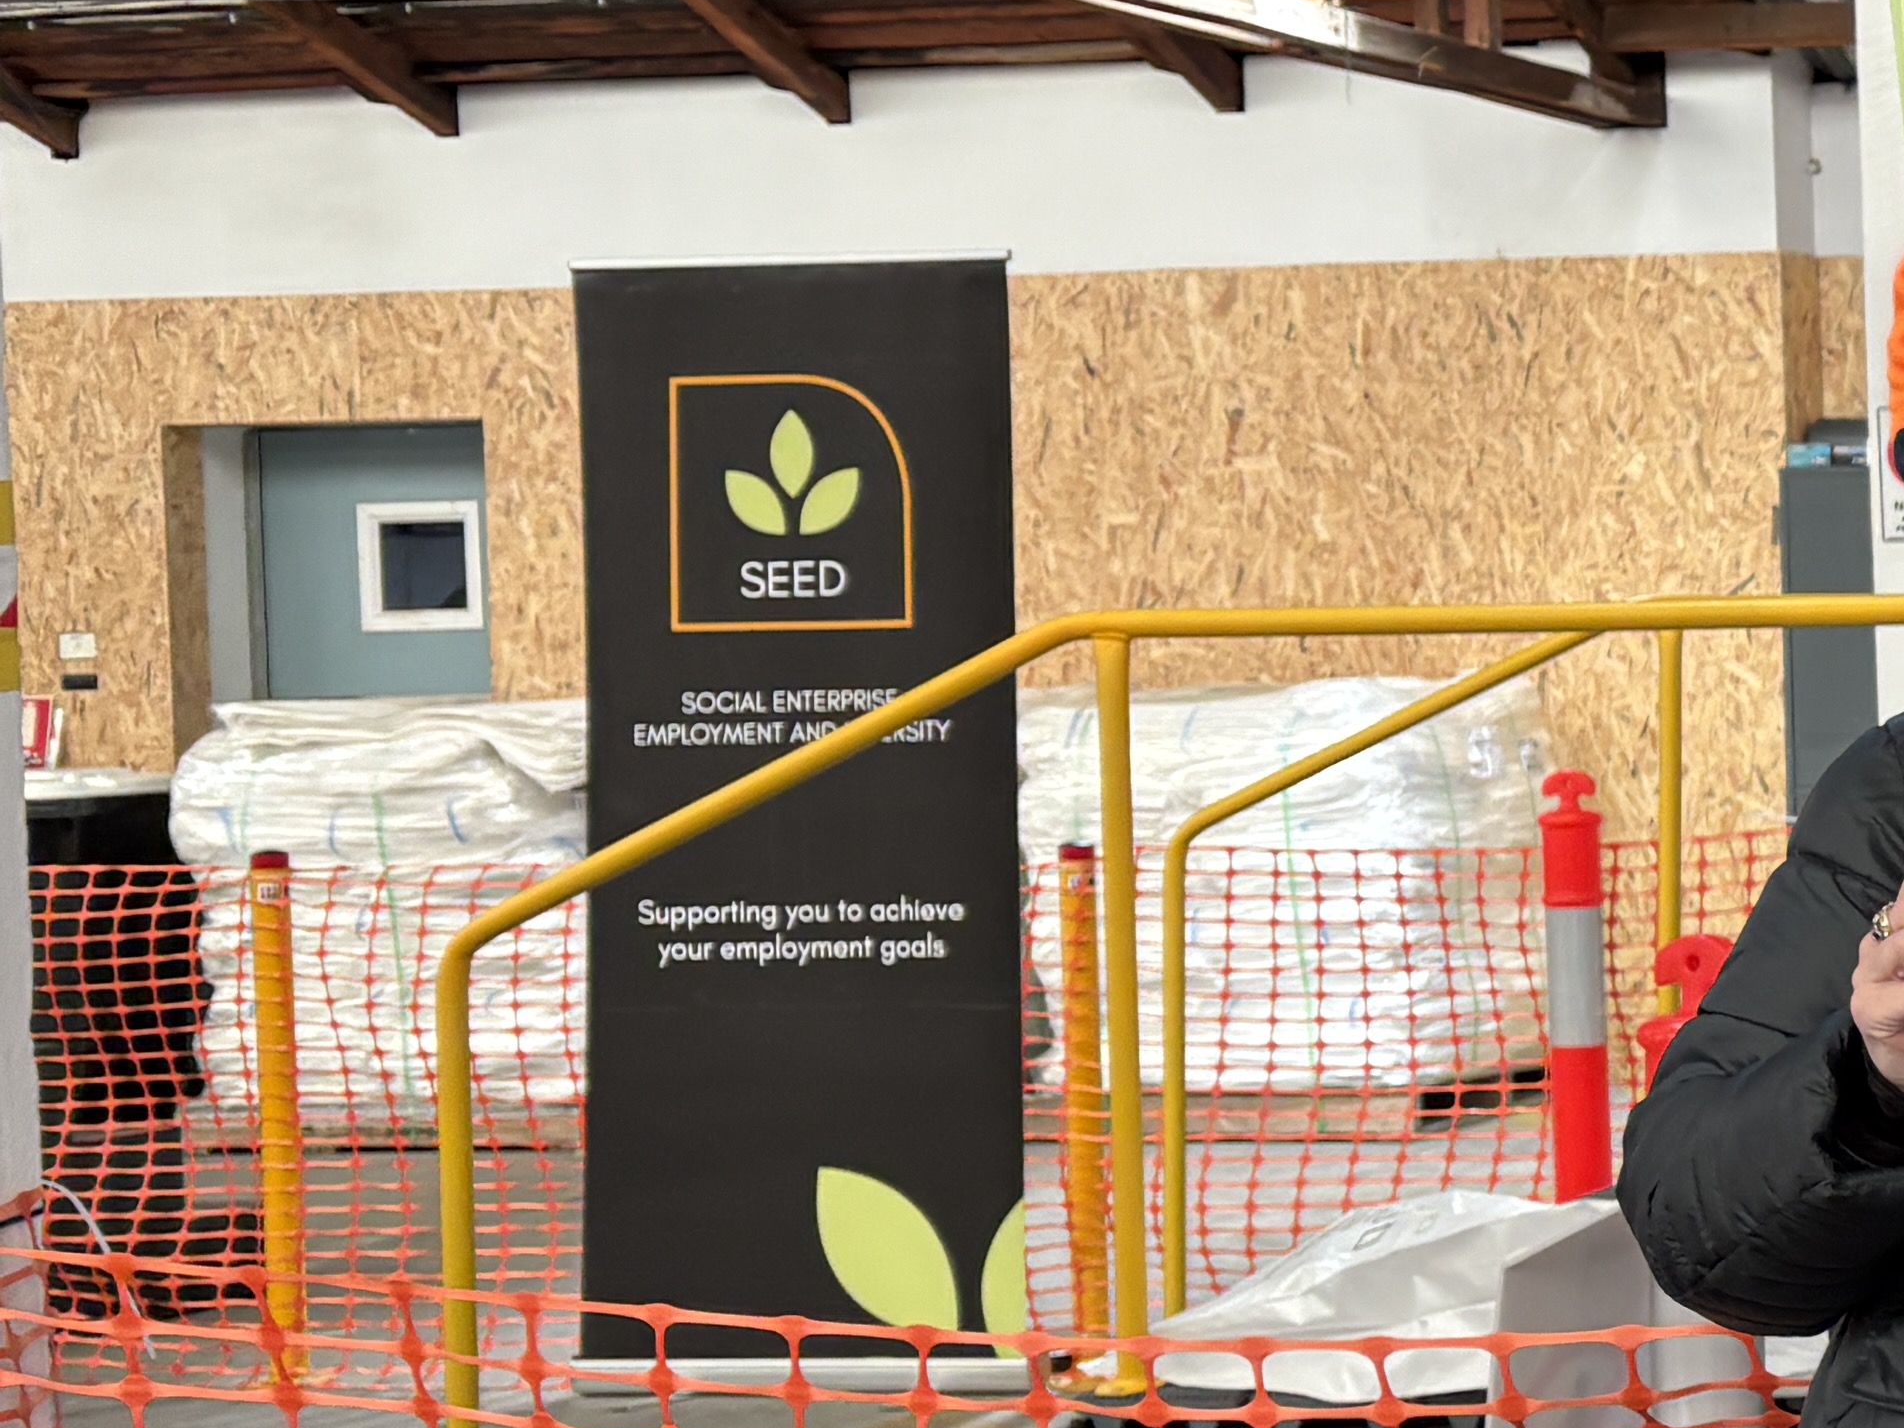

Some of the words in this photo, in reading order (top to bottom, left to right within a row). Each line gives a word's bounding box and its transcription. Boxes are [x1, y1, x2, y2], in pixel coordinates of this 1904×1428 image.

[740, 559, 846, 599] SEED
[681, 690, 768, 715] SOCIAL
[633, 721, 785, 746] EMPLOYMENT
[637, 898, 777, 931] Supporting
[785, 902, 830, 930] you
[837, 899, 863, 922] to
[870, 893, 965, 922] achieve
[658, 939, 713, 968] your
[720, 932, 872, 967] employment
[880, 930, 948, 965] goals
